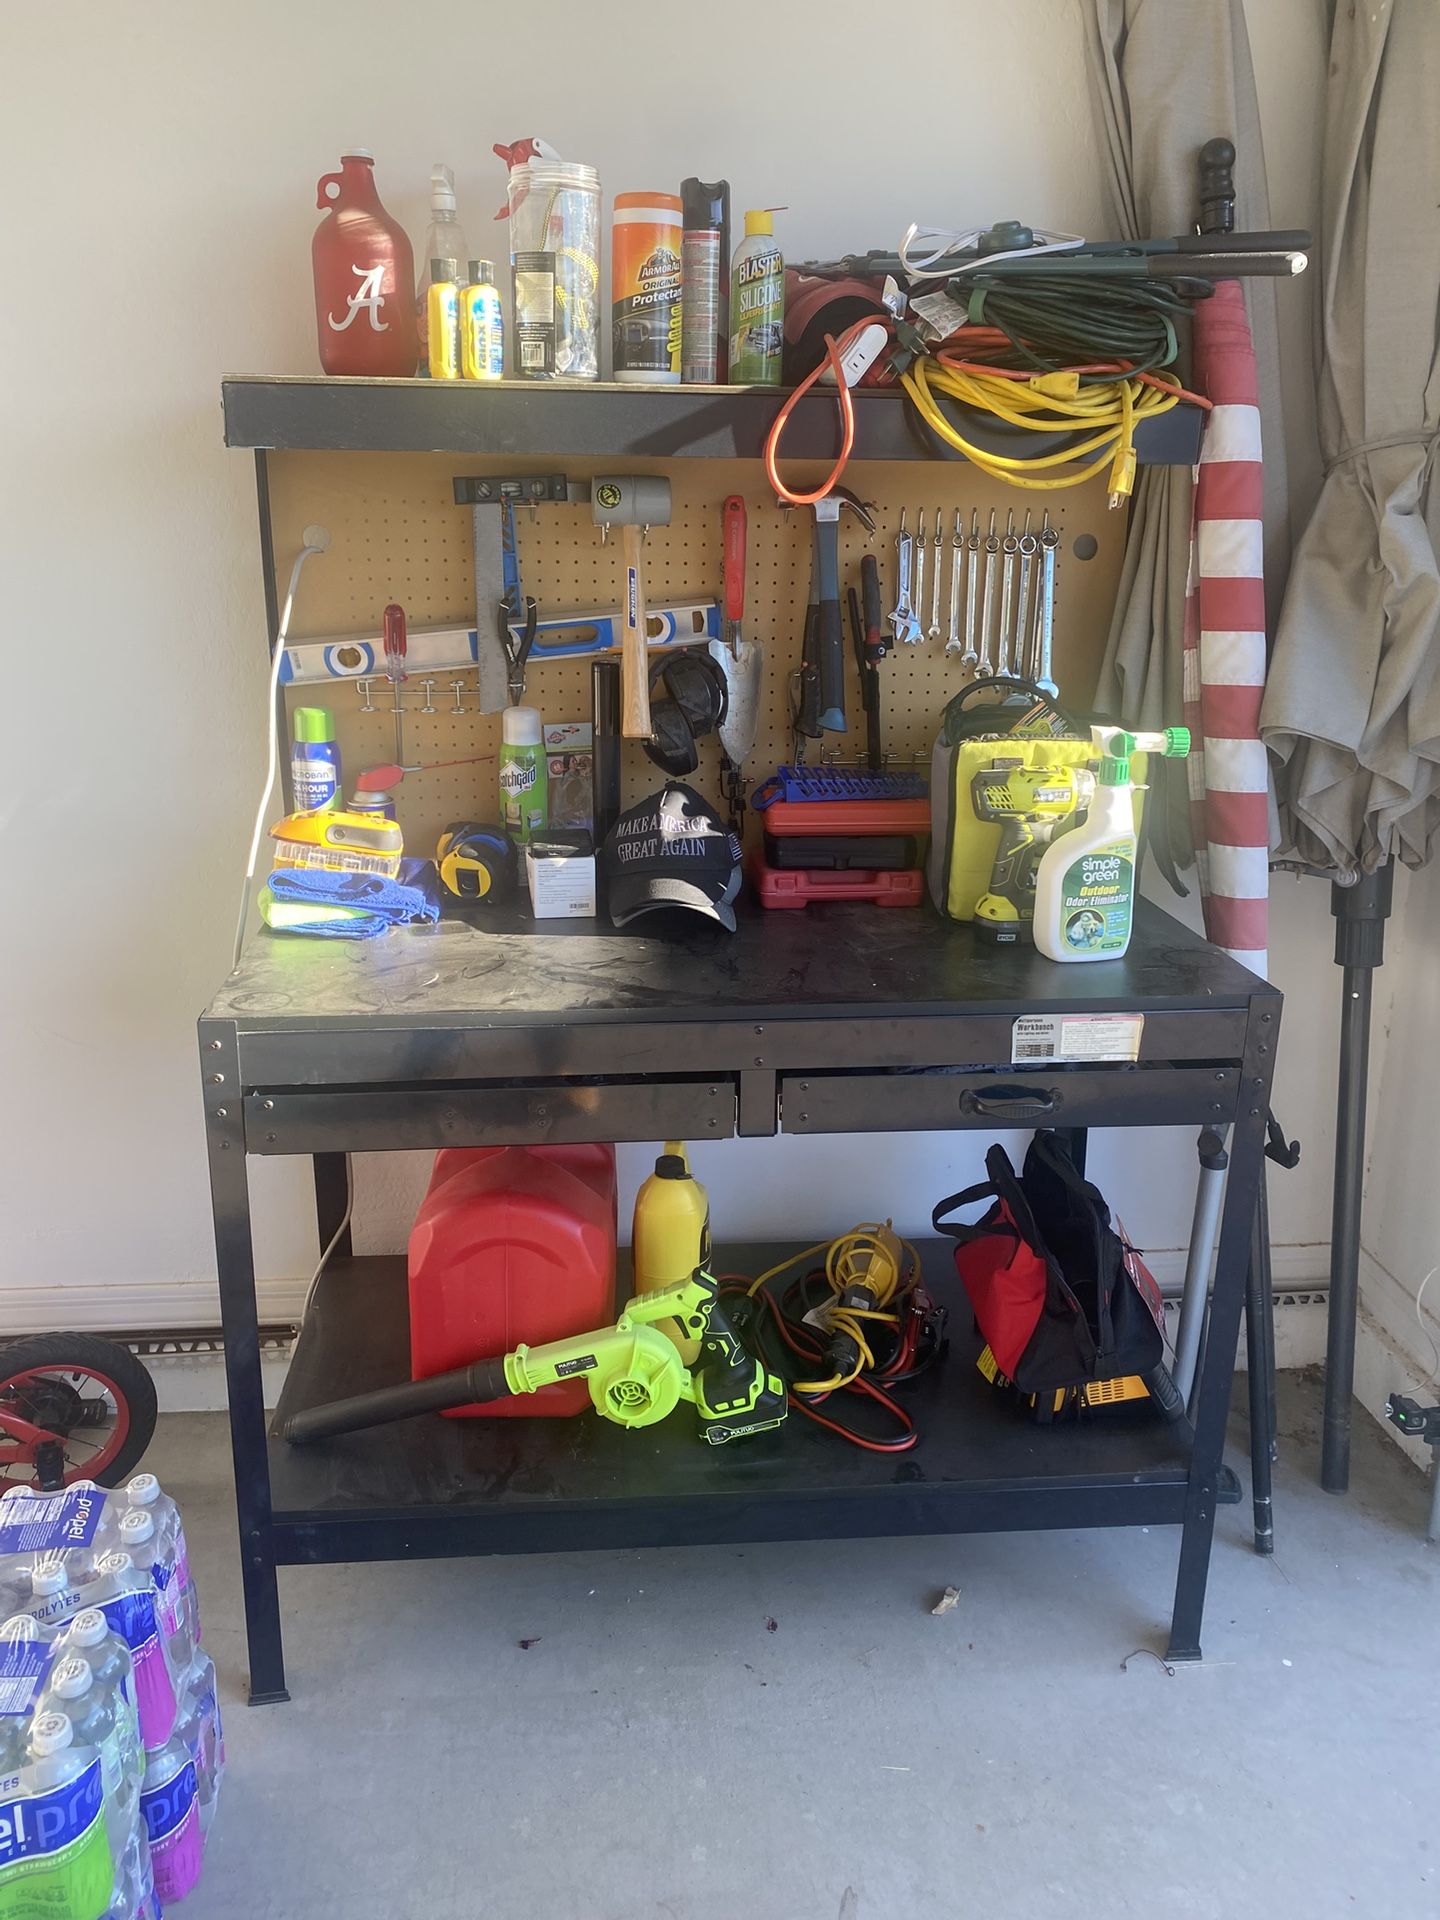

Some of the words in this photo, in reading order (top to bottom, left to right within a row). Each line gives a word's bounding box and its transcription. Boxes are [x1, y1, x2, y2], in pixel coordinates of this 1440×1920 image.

[740, 280, 782, 313] SILICONE
[302, 783, 328, 793] HOUR
[616, 818, 650, 839] MAKE
[649, 812, 709, 833] AMERICA
[617, 838, 658, 864] GREAT
[660, 839, 706, 857] AGAIN
[1082, 856, 1121, 872] simple
[1083, 869, 1119, 885] green
[1080, 885, 1120, 897] Outdoor
[1065, 896, 1089, 907] Odor
[1090, 893, 1129, 906] Eliminator
[1017, 1023, 1054, 1031] Workbench
[67, 1498, 93, 1540] propel
